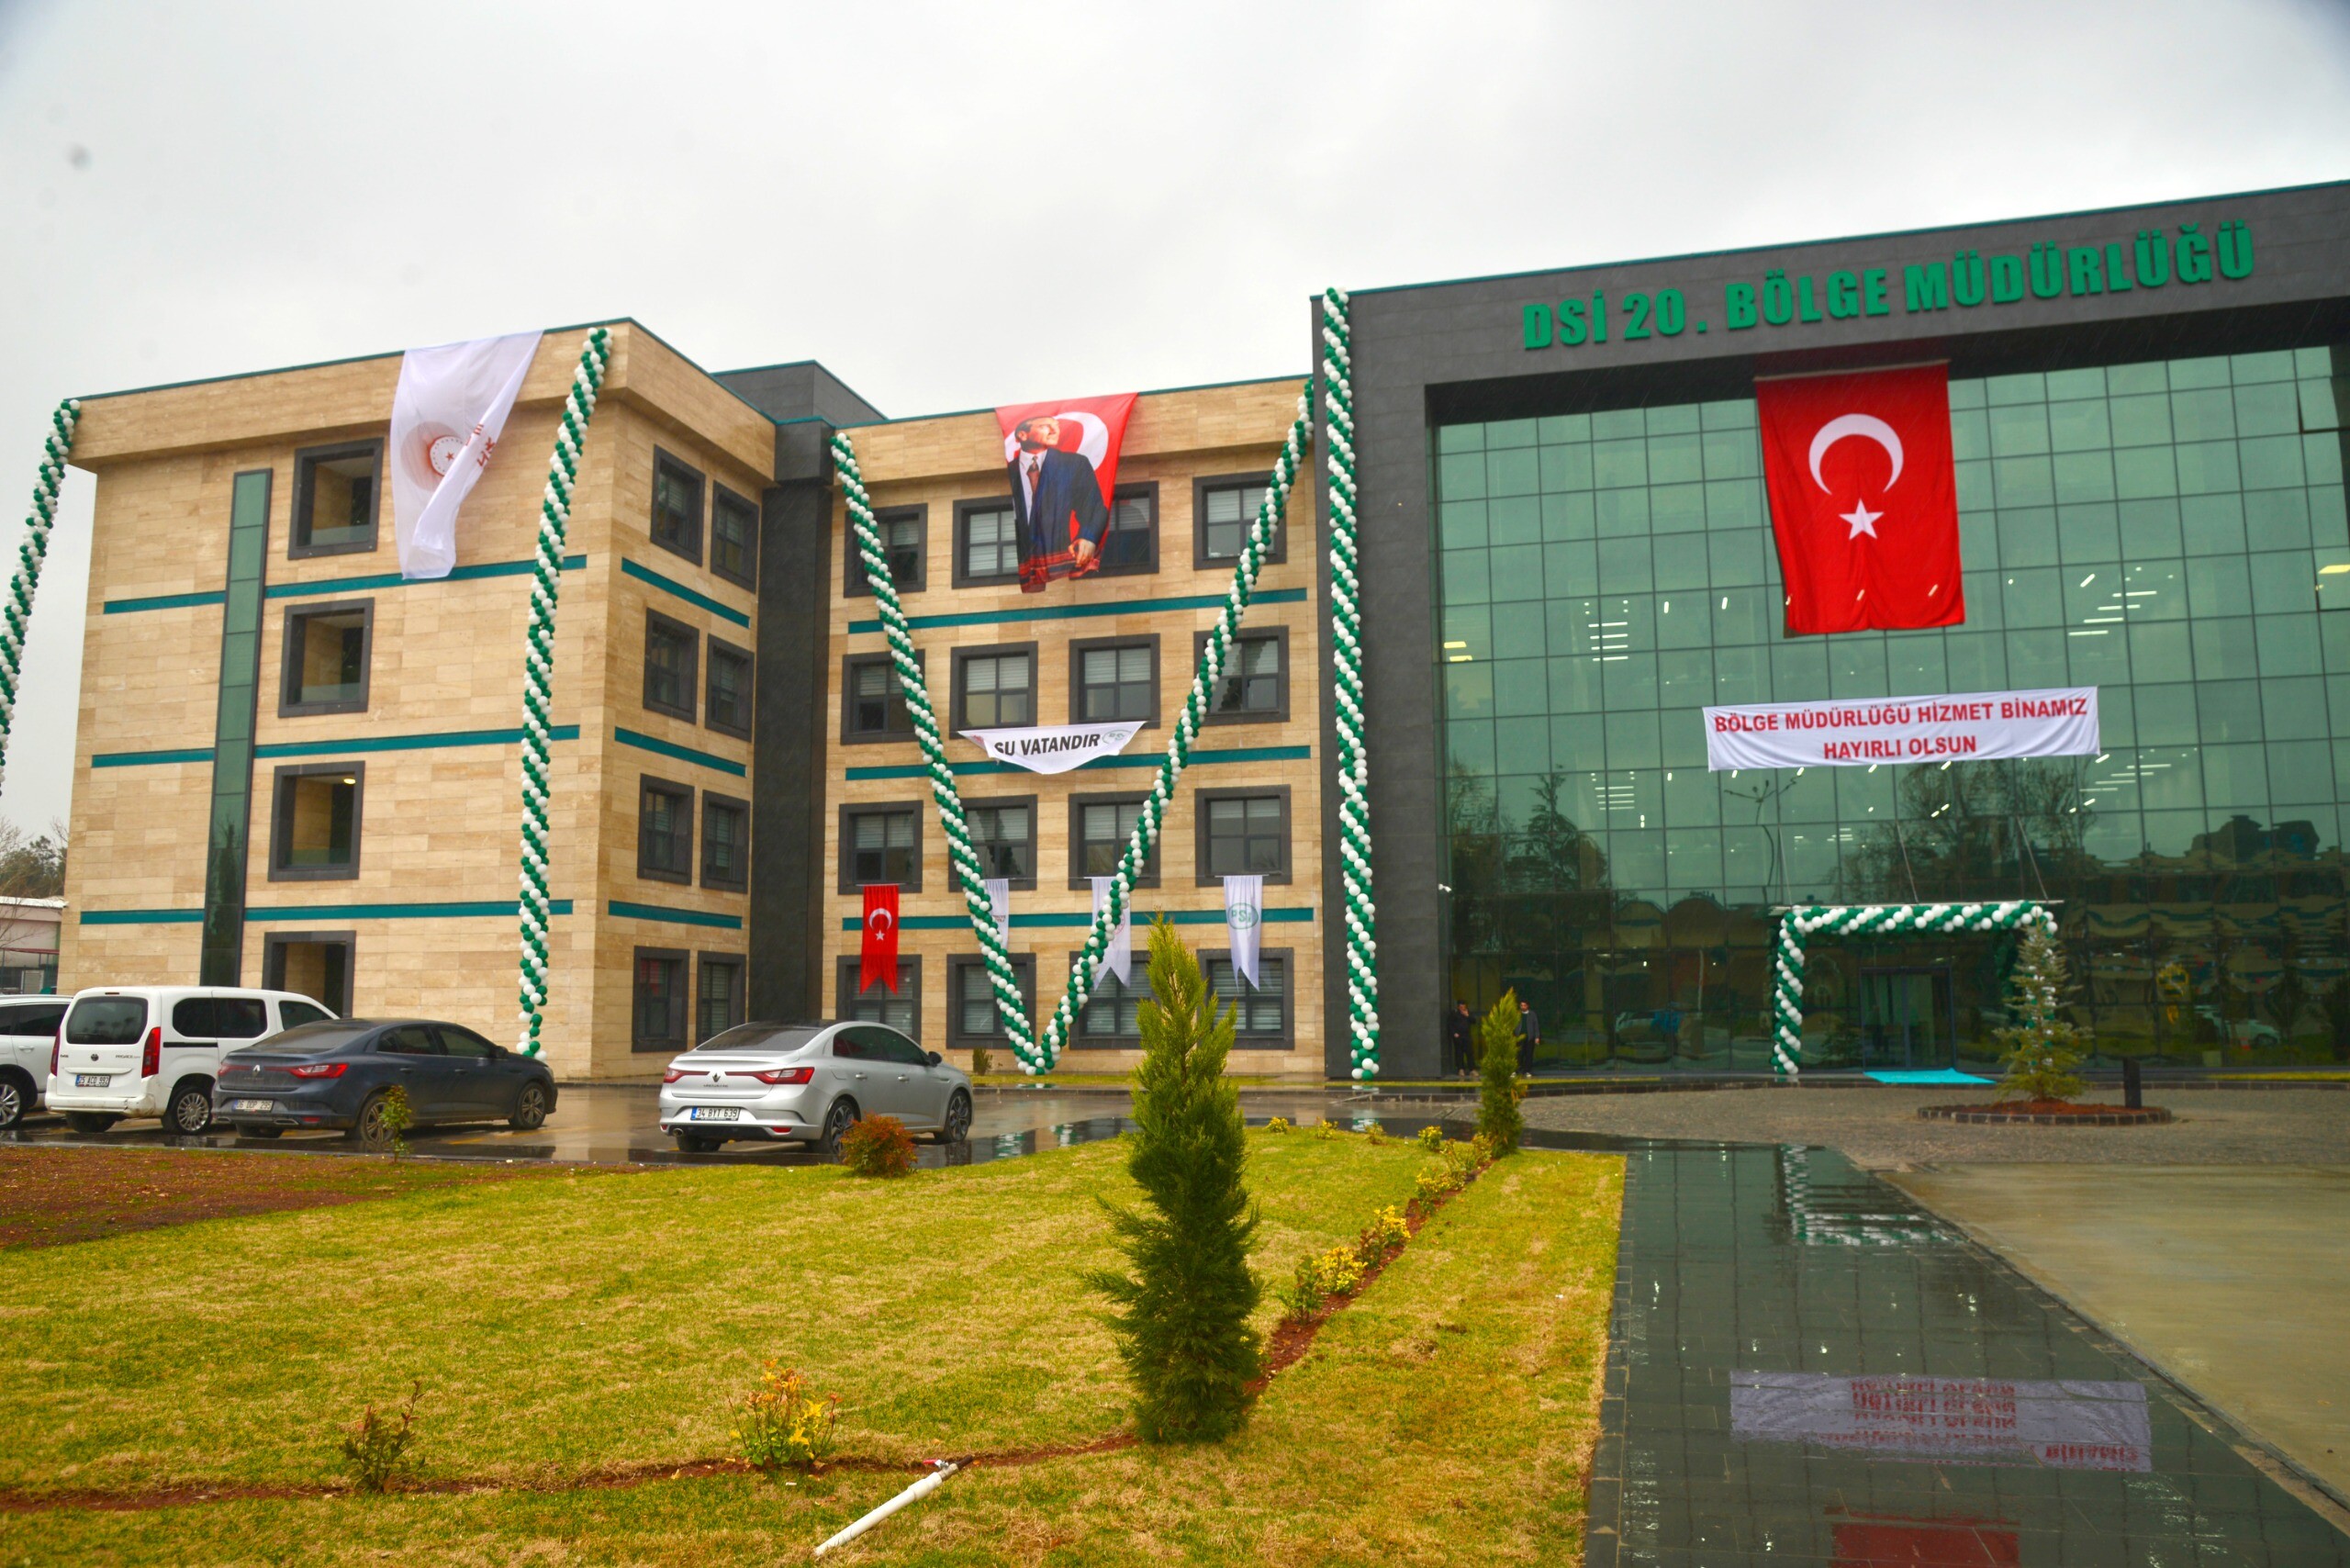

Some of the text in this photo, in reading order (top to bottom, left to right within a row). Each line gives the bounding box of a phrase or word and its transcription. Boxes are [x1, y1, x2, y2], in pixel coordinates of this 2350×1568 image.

[1523, 288, 1607, 350] DSİ
[1726, 268, 1890, 330] BÖLGE
[1904, 218, 2255, 313] MÜDÜRLÜĞÜ
[1714, 697, 2087, 733] BÖLGE MÜDÜRLÜĞÜ HİZMET BİNAMIZ
[1020, 734, 1101, 756] VATANDIR
[1823, 735, 1976, 759] HAYIRLI OLSUN
